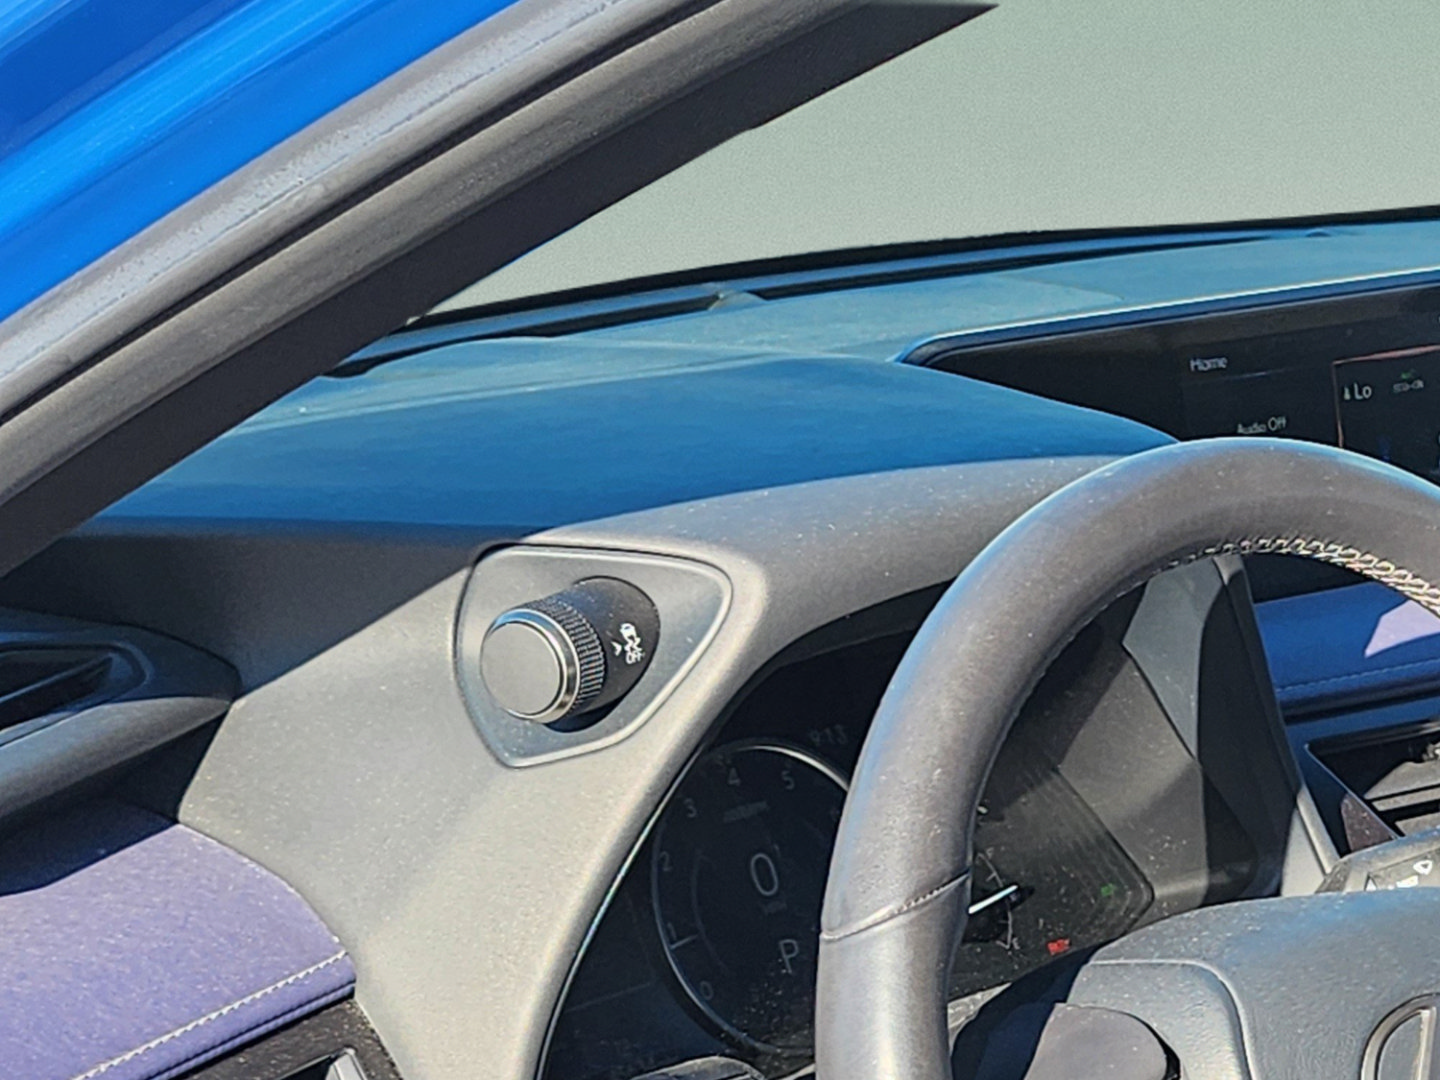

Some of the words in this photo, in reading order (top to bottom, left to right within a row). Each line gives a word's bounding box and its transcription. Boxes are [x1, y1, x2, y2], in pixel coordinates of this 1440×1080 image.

[1189, 356, 1228, 372] Home
[1353, 382, 1373, 401] Lo
[1267, 416, 1287, 432] Off
[728, 766, 741, 787] 4
[781, 769, 796, 791] 5
[683, 797, 698, 819] 3
[749, 852, 779, 897] 0
[779, 938, 800, 975] P
